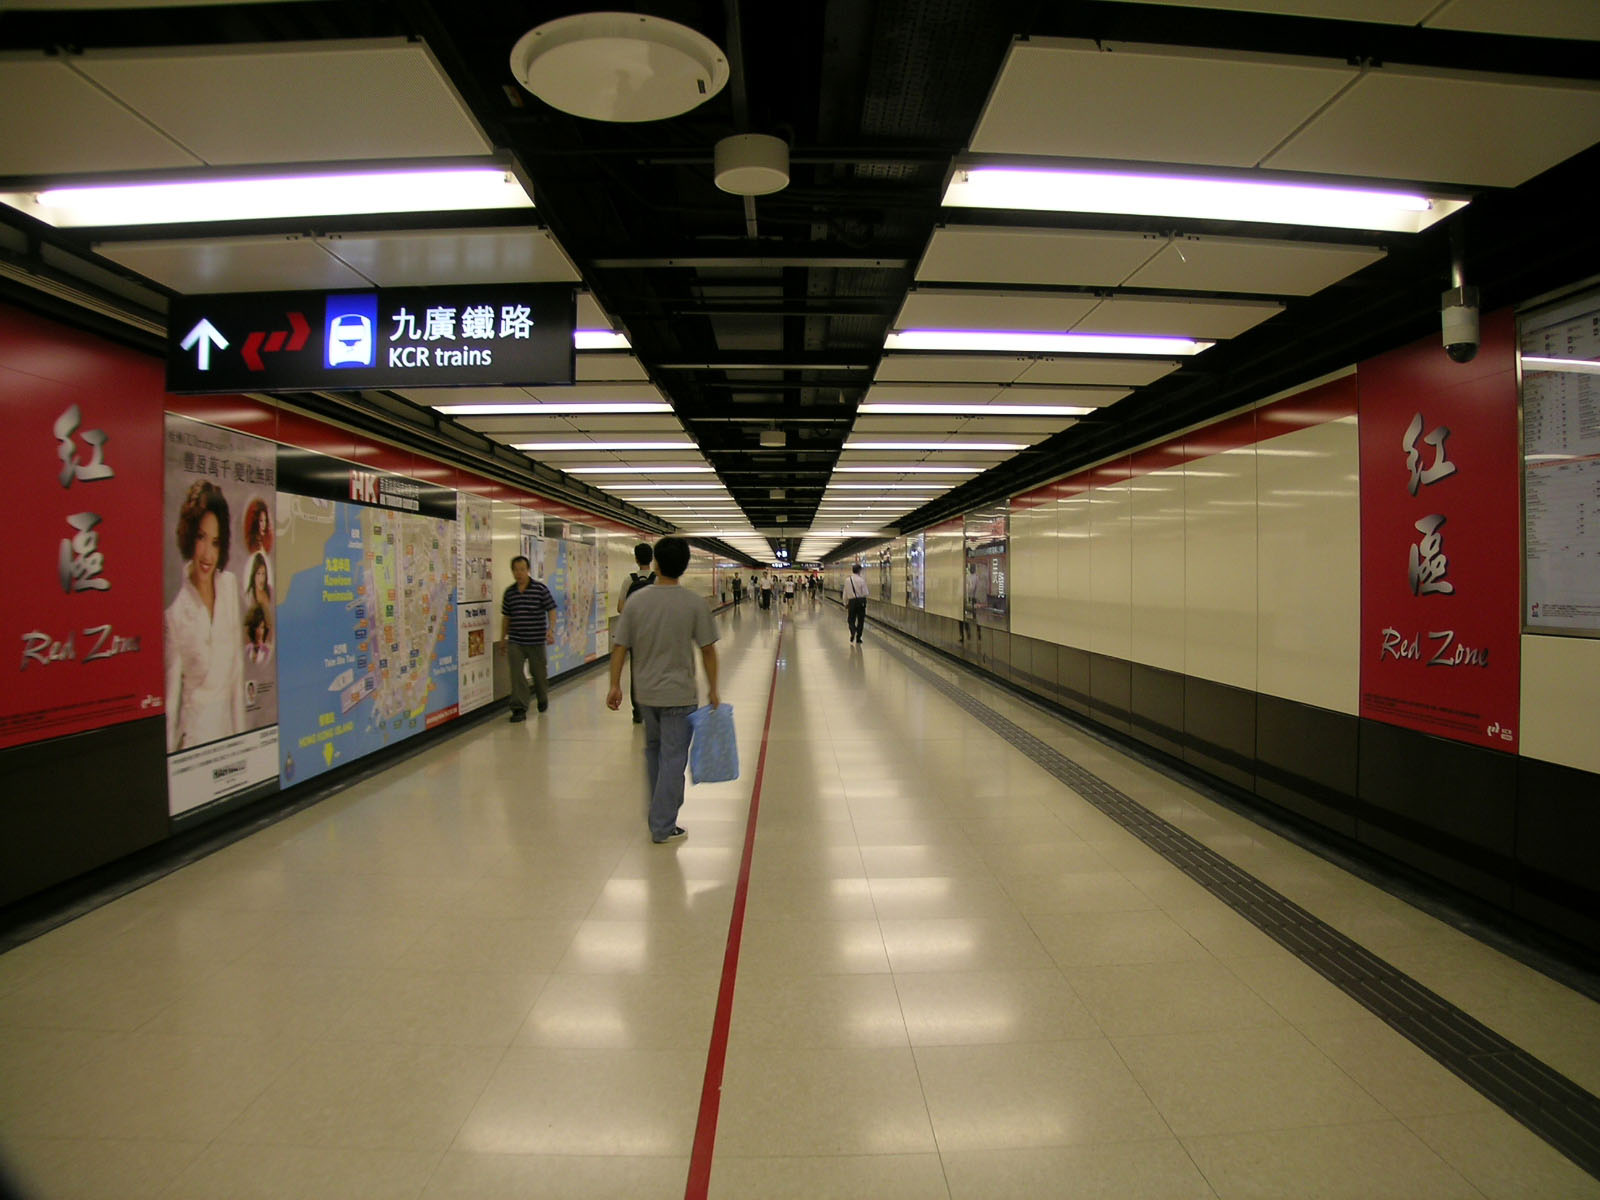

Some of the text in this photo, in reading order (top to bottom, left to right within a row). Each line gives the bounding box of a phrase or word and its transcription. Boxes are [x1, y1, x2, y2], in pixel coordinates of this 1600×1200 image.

[389, 304, 534, 342] 九廣鐵路
[389, 345, 492, 368] KCR trains
[53, 404, 116, 594] 紅區
[351, 469, 378, 504] HK
[1402, 411, 1458, 597] 紅區
[20, 624, 142, 672] Red Zone
[1381, 626, 1489, 668] Red Zone
